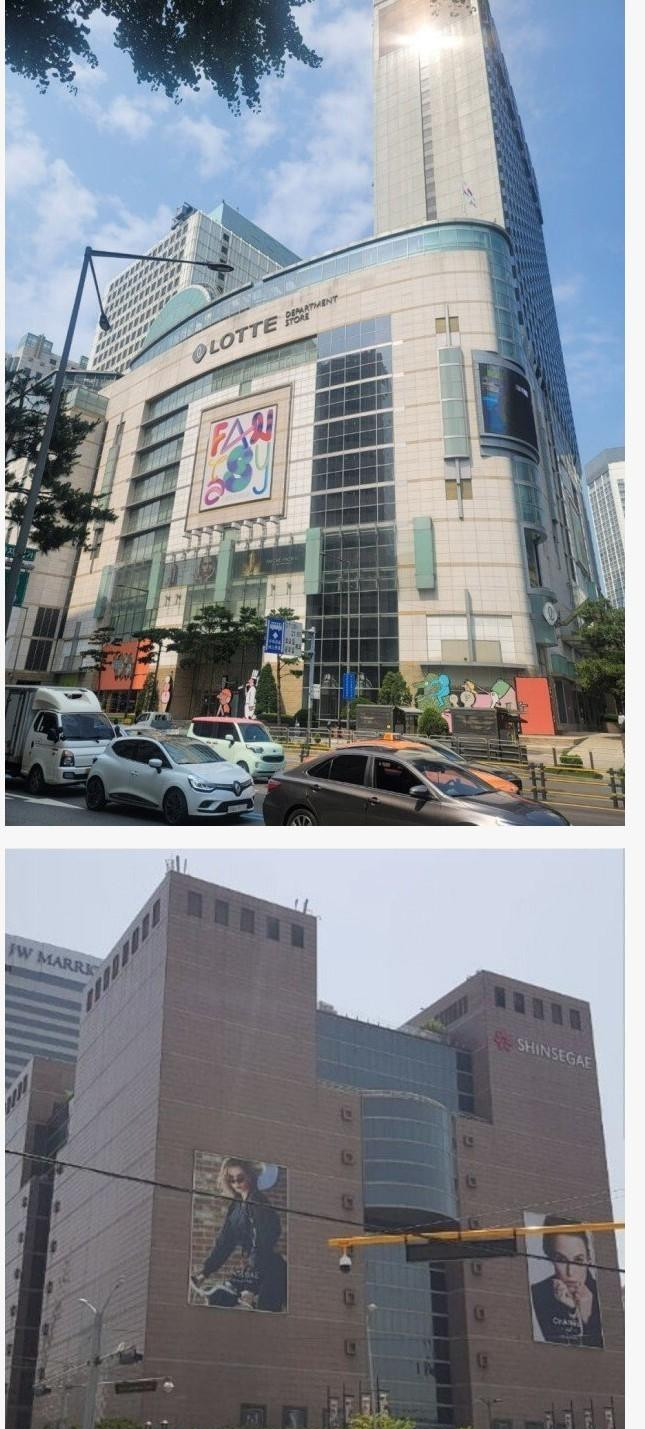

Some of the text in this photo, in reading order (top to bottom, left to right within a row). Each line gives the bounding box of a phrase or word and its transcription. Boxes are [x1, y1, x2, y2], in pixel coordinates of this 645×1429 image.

[285, 295, 338, 318] DEPARTMENT
[285, 312, 310, 327] STORE
[209, 315, 278, 354] LOTTE
[8, 943, 33, 959] JW
[516, 1038, 593, 1070] SHINSEGAE
